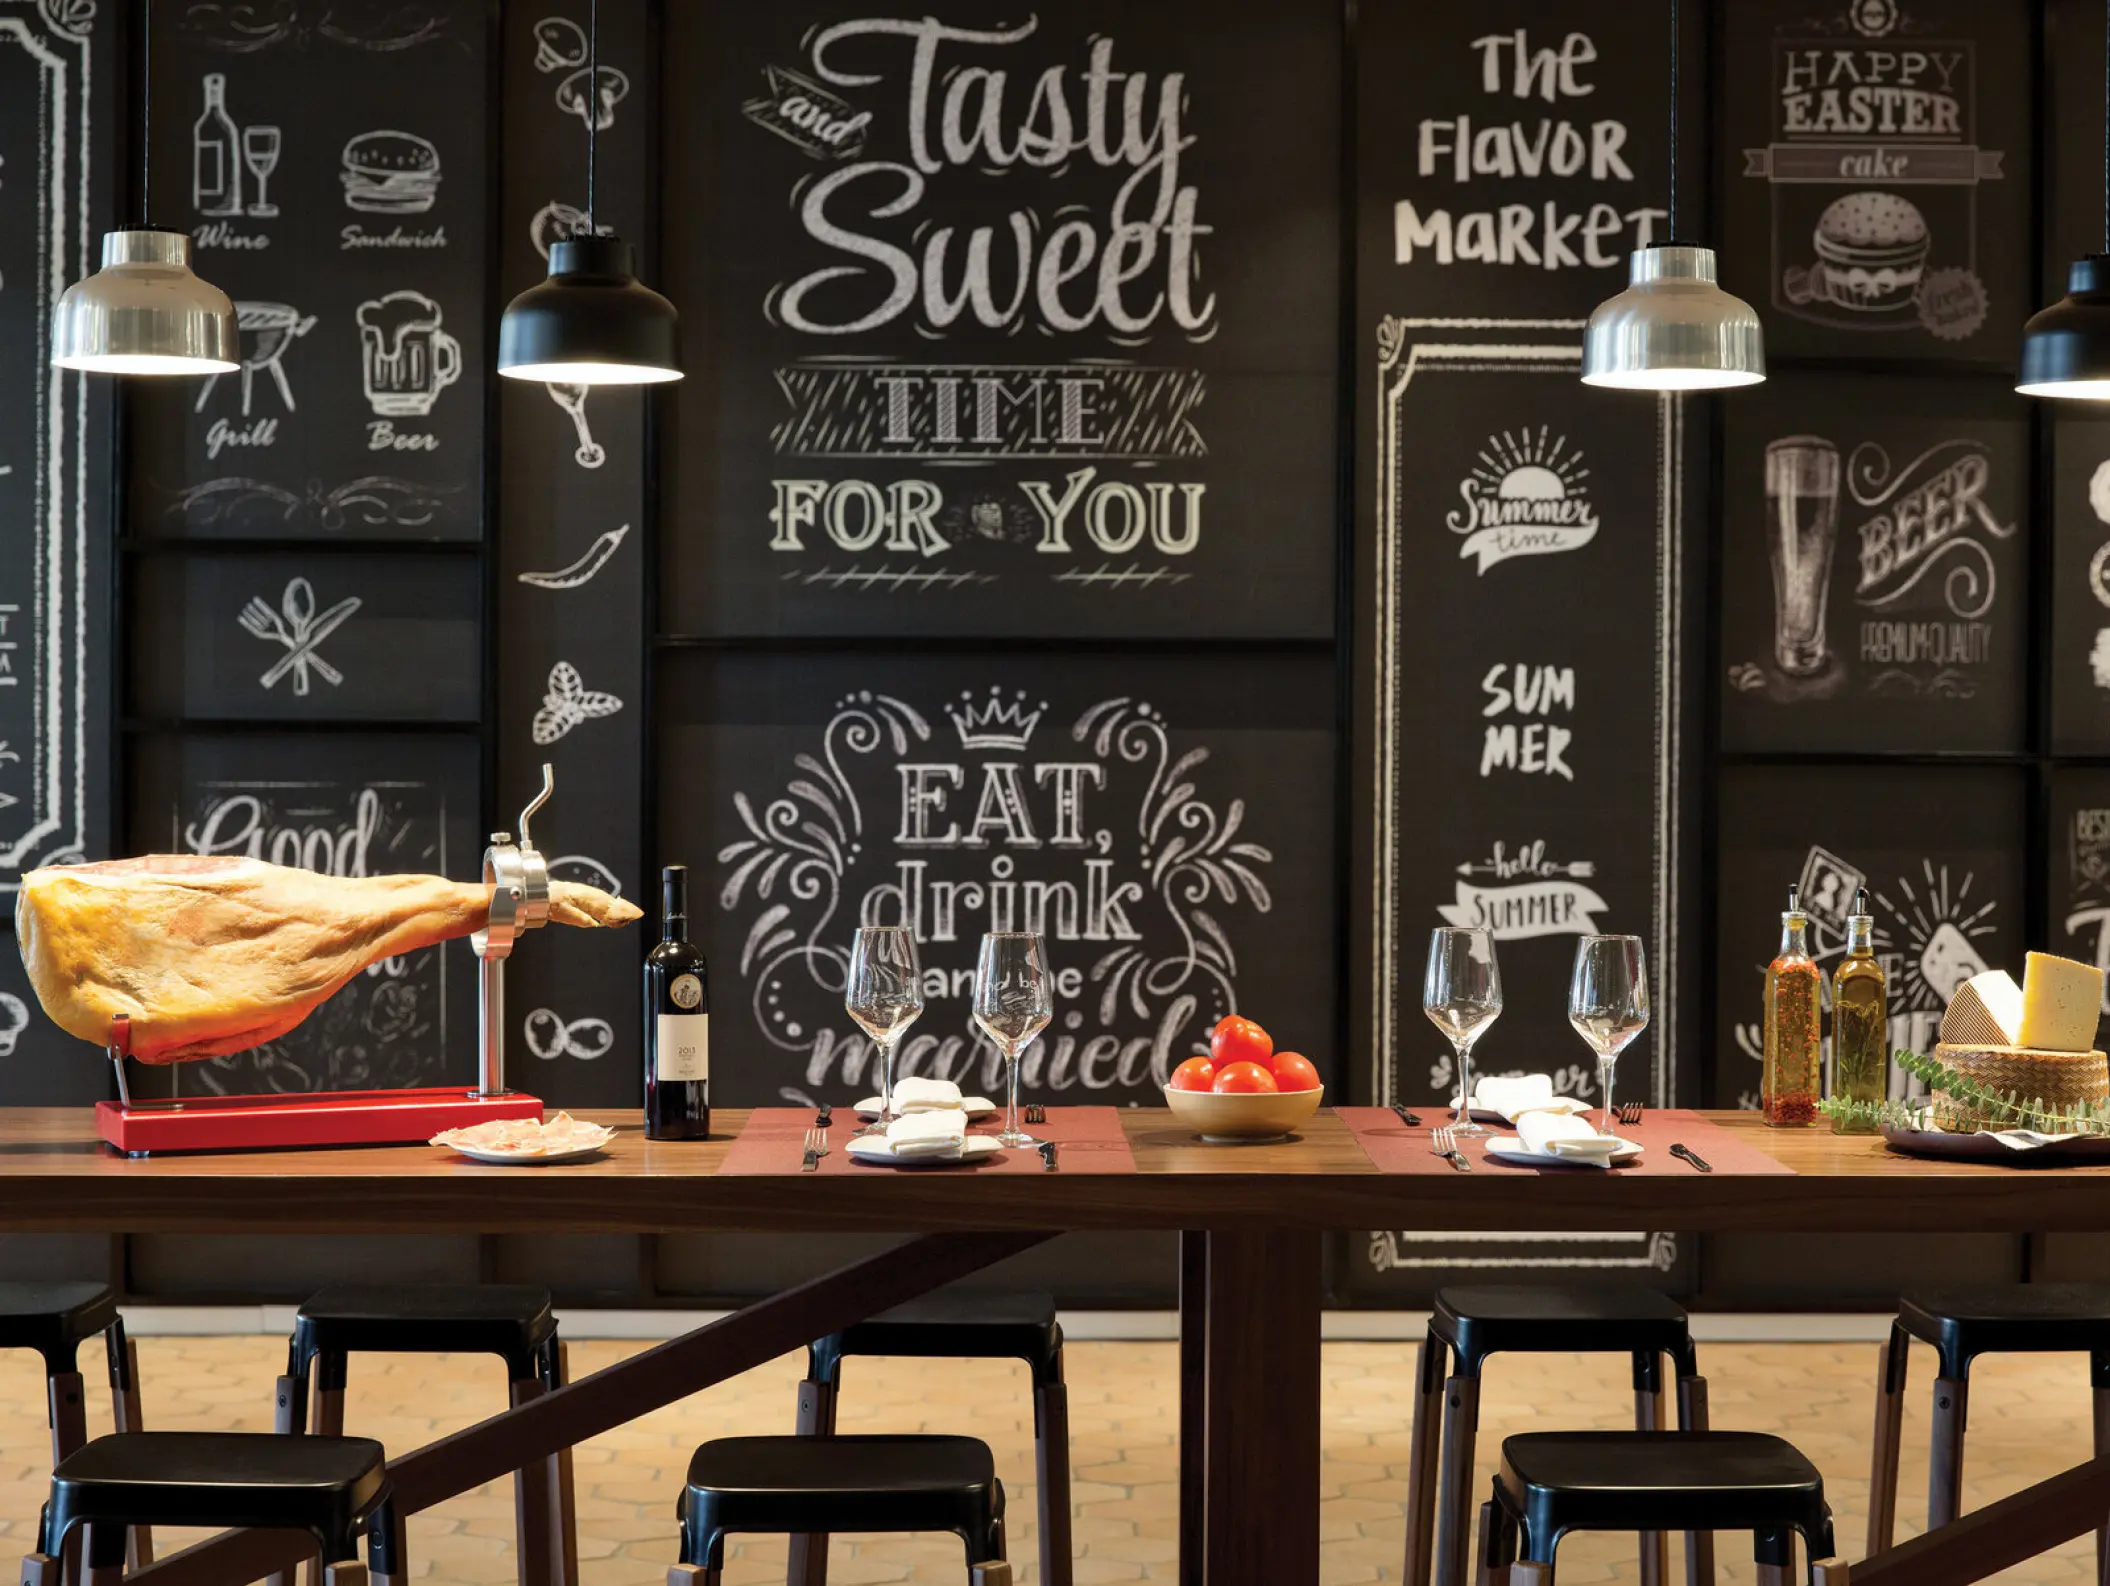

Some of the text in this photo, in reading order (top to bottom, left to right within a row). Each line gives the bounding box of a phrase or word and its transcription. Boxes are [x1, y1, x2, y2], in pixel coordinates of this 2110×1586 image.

[1471, 29, 1598, 102] The
[1781, 50, 1963, 95] HAPPY
[780, 96, 872, 146] and
[812, 14, 1197, 232] Tasty
[1782, 86, 1961, 134] EASTER
[1839, 147, 1909, 178] cake
[193, 221, 270, 251] Wine
[339, 225, 447, 250] Sandwich
[779, 160, 1216, 335] Sweet
[366, 420, 440, 451] Beer
[873, 375, 1106, 445] TIME
[206, 418, 276, 459] Grill
[769, 465, 1206, 557] FOR YOU
[1446, 478, 1598, 534] Summer
[1856, 453, 2018, 594] BEER
[1487, 530, 1566, 551] time
[1480, 662, 1576, 717] SUM
[1480, 722, 1574, 781] MER
[893, 762, 1113, 854] EAT,
[1490, 839, 1560, 879] hello
[860, 855, 1143, 944] drink
[1469, 892, 1578, 931] SUMMER
